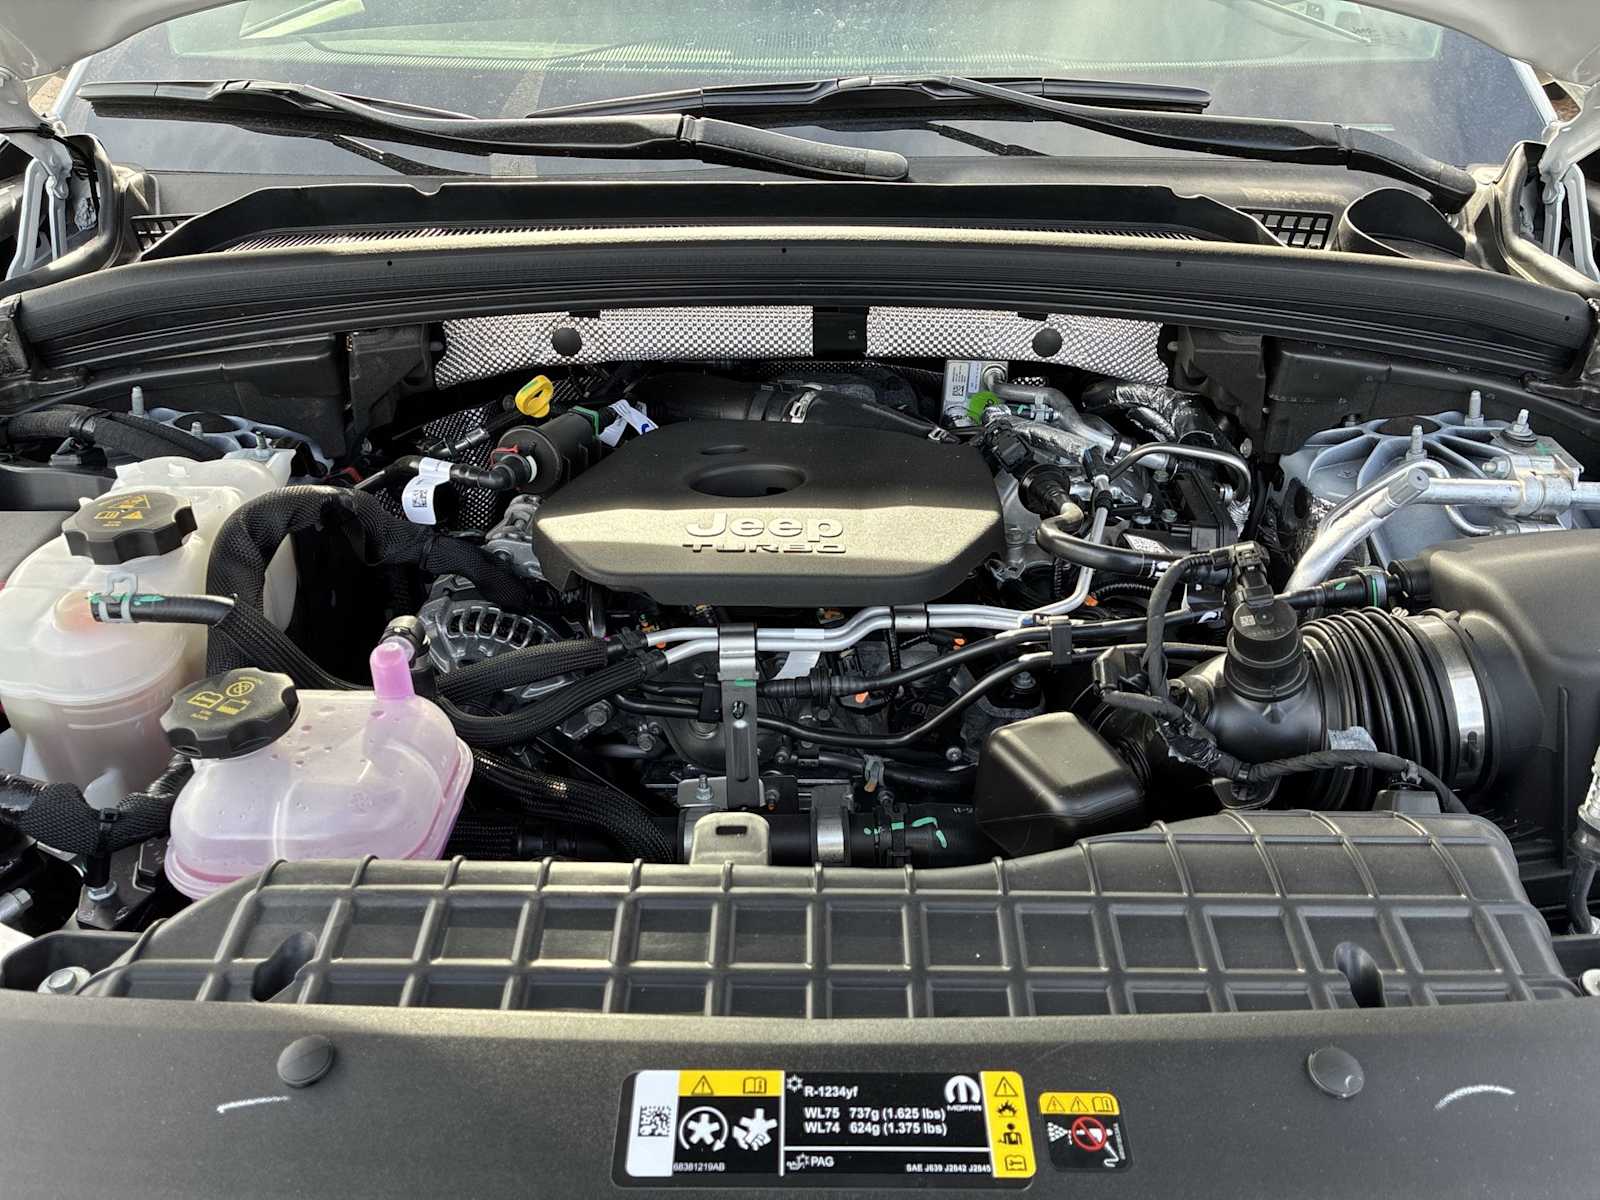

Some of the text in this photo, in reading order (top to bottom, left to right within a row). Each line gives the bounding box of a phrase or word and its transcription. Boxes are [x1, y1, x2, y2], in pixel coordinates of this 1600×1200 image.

[685, 512, 844, 542] Jeep
[682, 544, 846, 554] TURBO
[804, 1086, 858, 1099] R-1234yf
[805, 1106, 945, 1120] WL75 737g (1.625 lbs)
[947, 1104, 982, 1112] MOPAR
[805, 1121, 947, 1136] WL74 624g (1.375 lbs)
[810, 1156, 834, 1167] PAG
